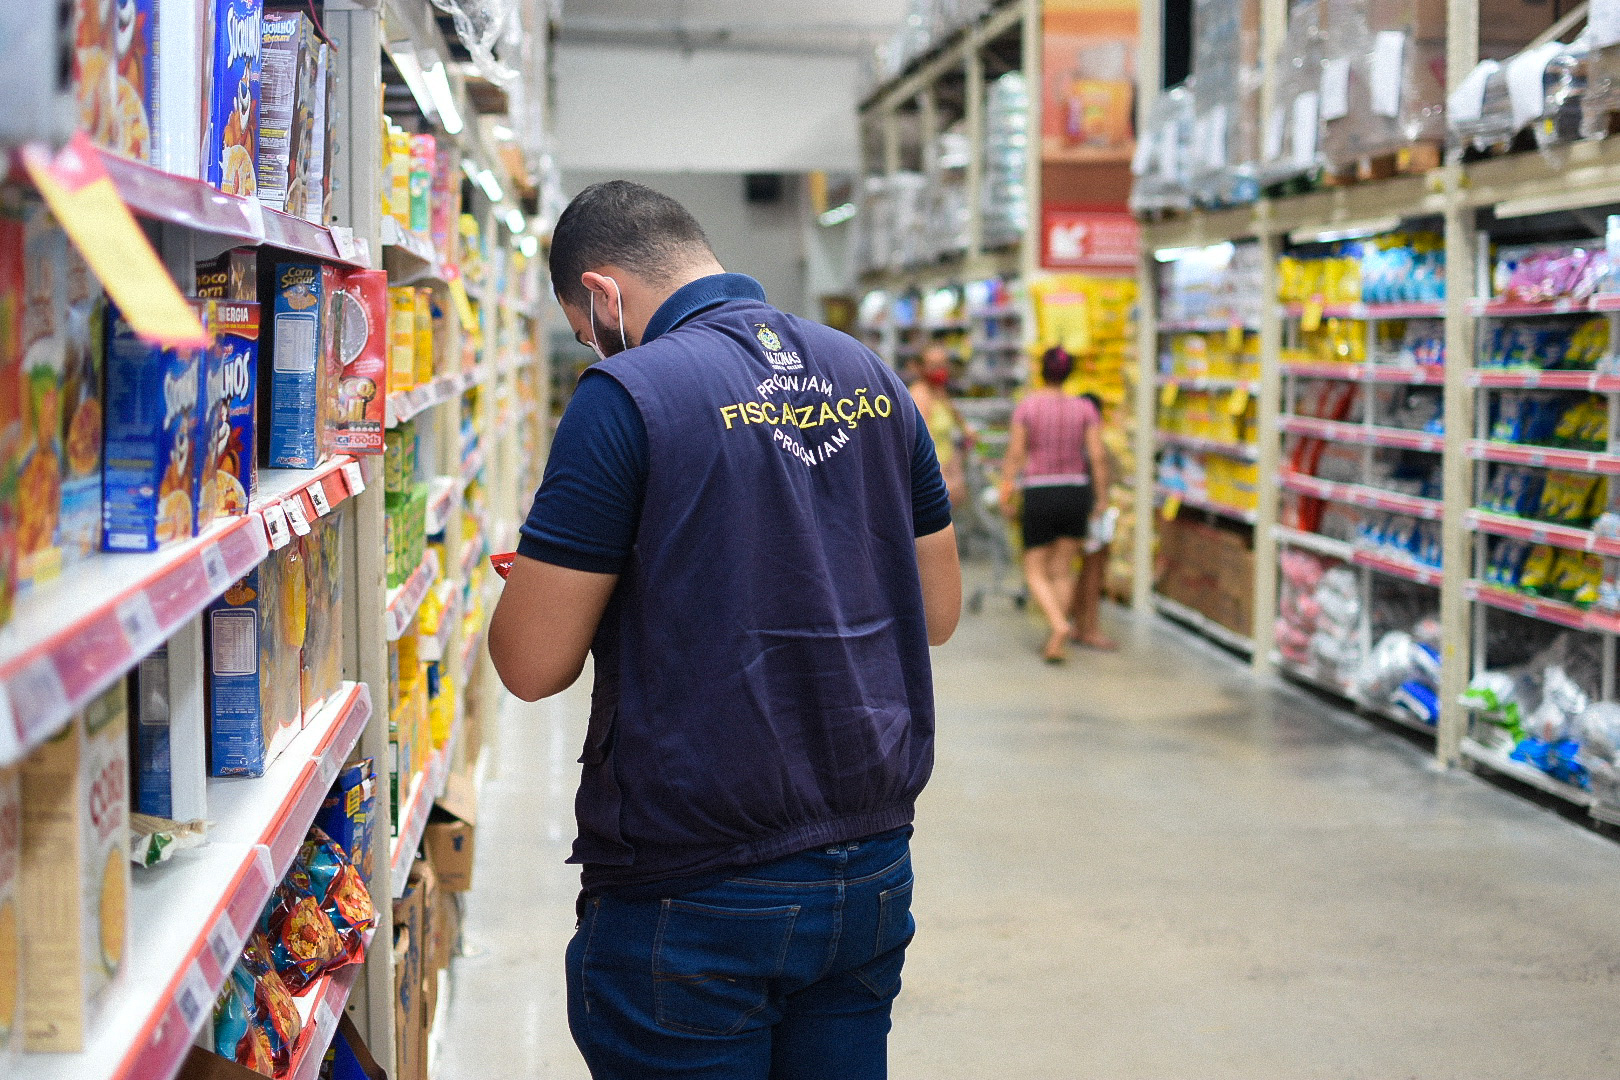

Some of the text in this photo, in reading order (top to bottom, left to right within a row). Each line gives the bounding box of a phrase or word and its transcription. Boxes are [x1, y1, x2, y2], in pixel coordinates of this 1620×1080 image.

[288, 267, 313, 278] Corn
[281, 274, 315, 288] Sugar
[719, 387, 892, 430] FISCAZAÇÃO
